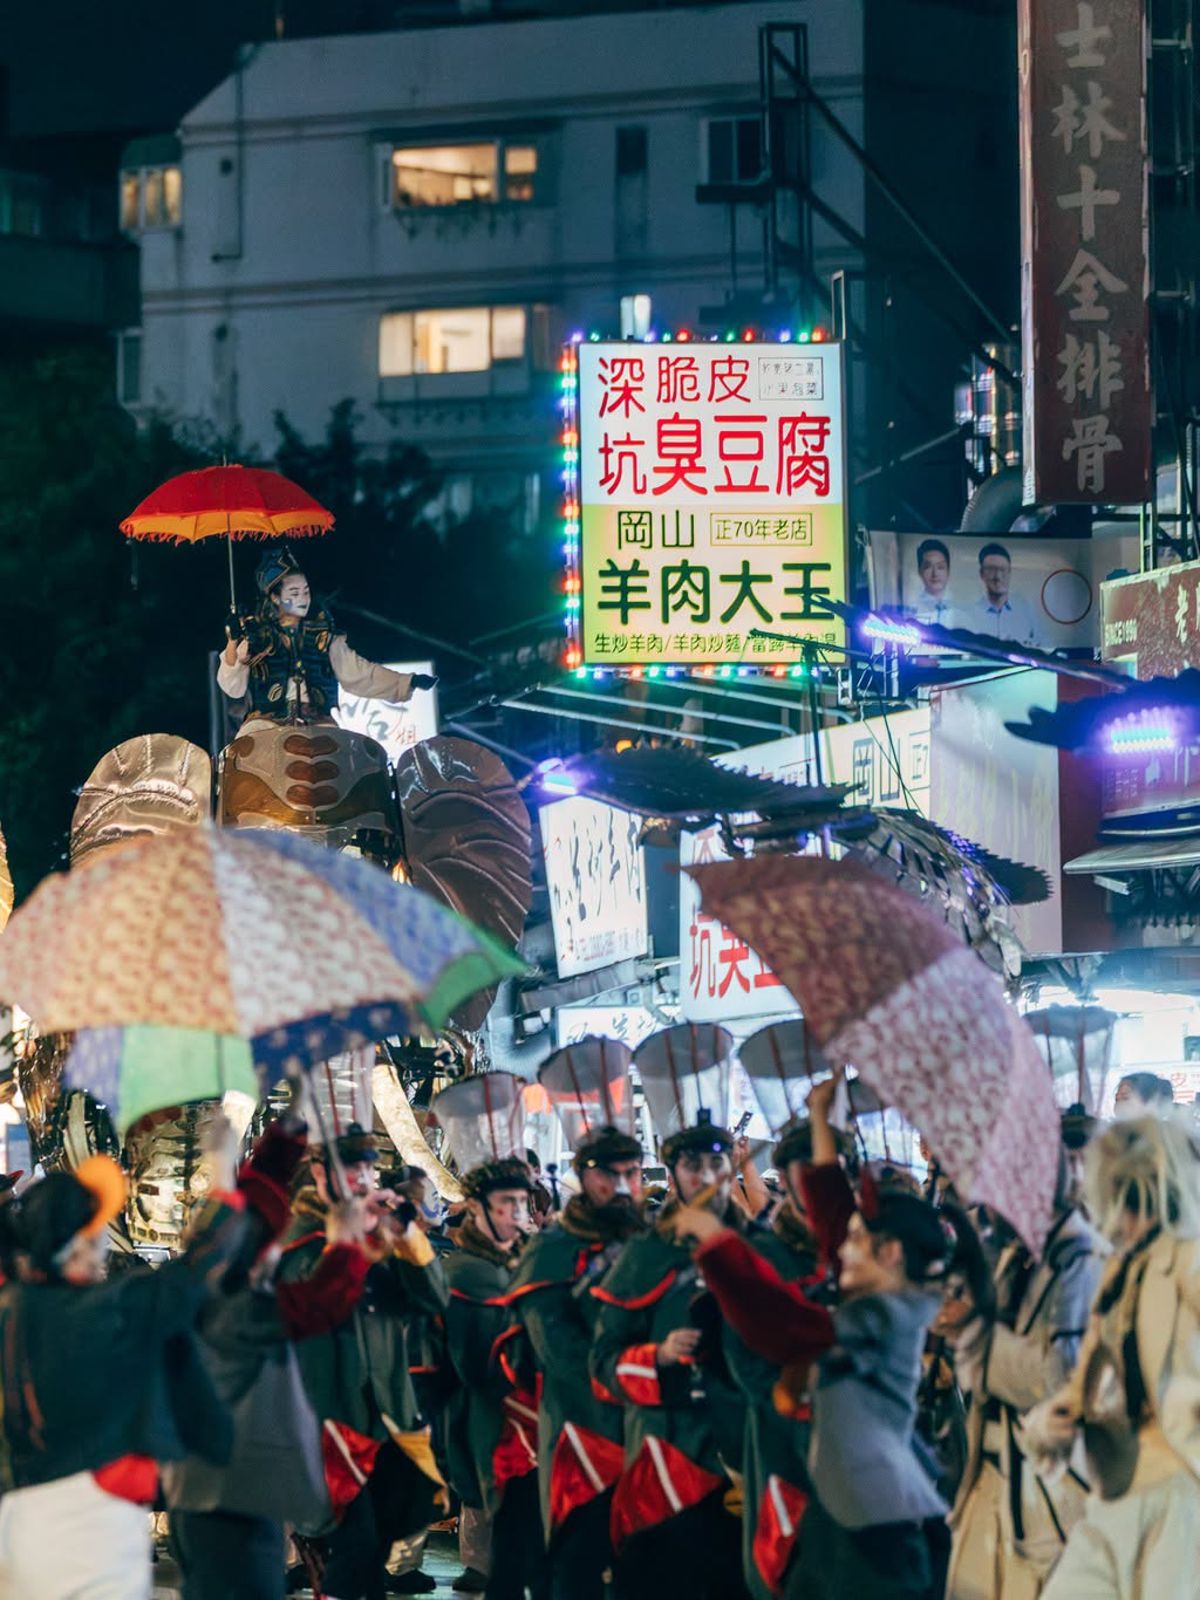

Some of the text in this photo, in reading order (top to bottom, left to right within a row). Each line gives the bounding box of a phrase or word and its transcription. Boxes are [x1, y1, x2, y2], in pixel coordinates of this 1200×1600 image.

[1050, 2, 1128, 495] 士林十全排骨
[655, 354, 752, 404] 脆皮
[651, 411, 832, 497] 臭豆腐
[617, 510, 695, 551] 岡山
[715, 518, 808, 542] 正70年老店
[597, 558, 836, 626] 羊肉大王
